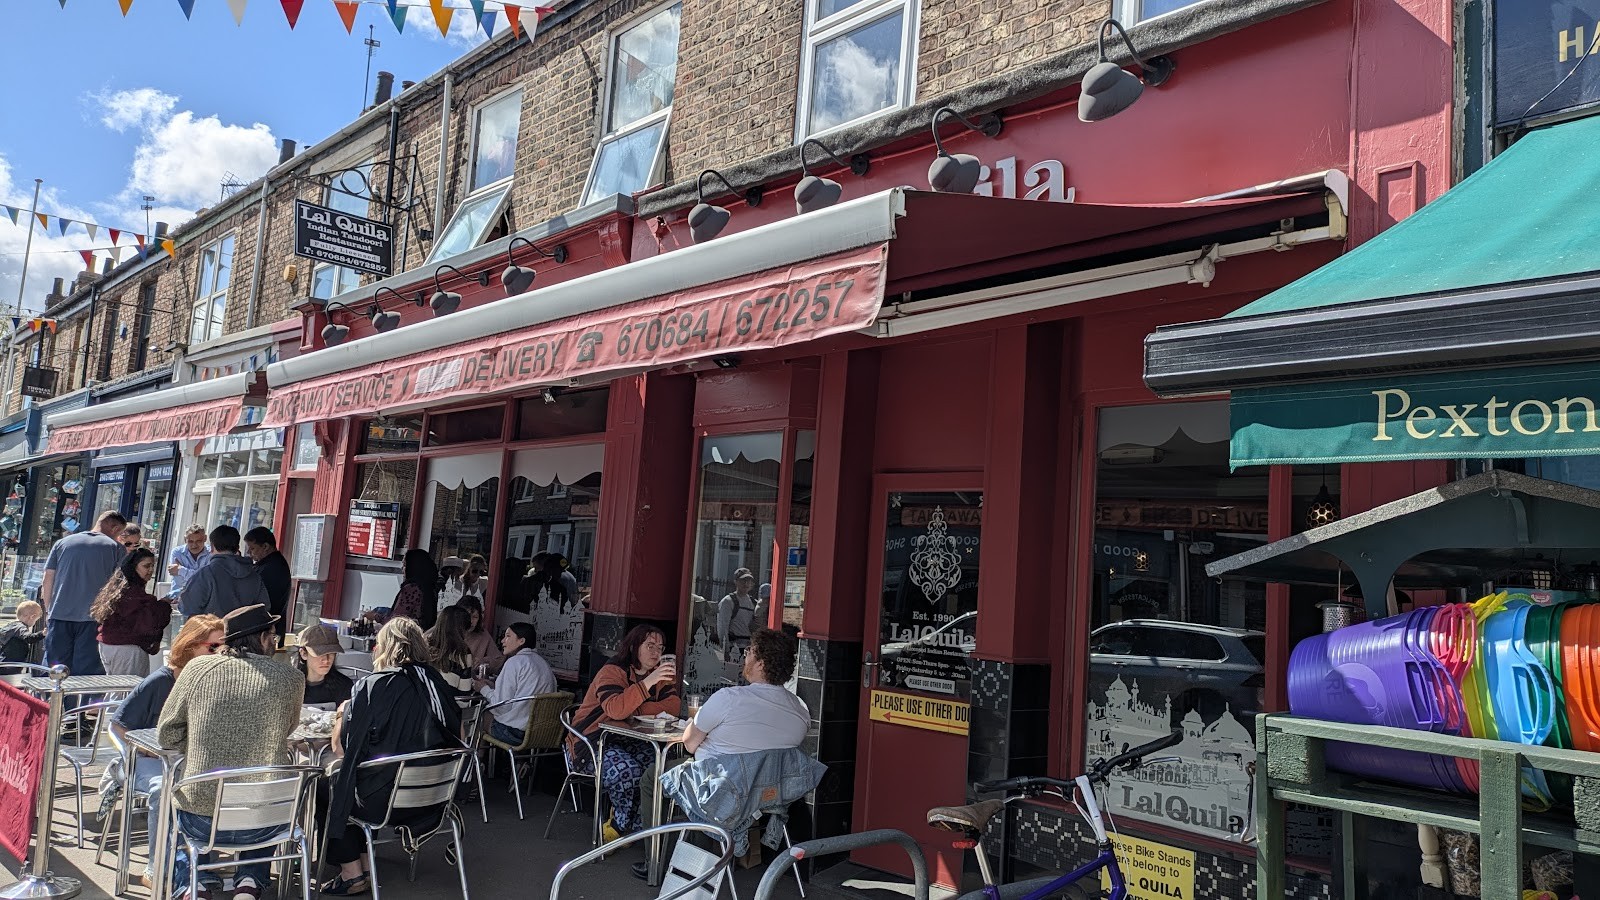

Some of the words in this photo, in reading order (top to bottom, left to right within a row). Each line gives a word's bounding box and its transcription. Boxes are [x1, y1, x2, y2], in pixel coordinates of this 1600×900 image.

[972, 157, 1076, 204] ila
[300, 205, 332, 226] Lal
[335, 216, 389, 241] Quila
[306, 222, 339, 236] Indian
[341, 231, 383, 248] Tandoori
[313, 241, 337, 252] Fully
[339, 247, 378, 261] Licensed
[319, 232, 372, 252] Restaurant
[303, 246, 314, 255] T:
[316, 250, 387, 273] 670684/672257
[272, 387, 334, 418] TAKEAWAY
[335, 374, 395, 407] SERVICE
[463, 338, 564, 383] DELIVERY
[617, 309, 709, 356] 670684
[736, 279, 855, 336] 672257
[173, 408, 231, 434] RESTAURANT
[1371, 388, 1600, 441] Pexton
[912, 611, 930, 621] Est.
[933, 613, 955, 622] 1990
[890, 622, 977, 649] LalQuila
[908, 678, 922, 686] PLEASE
[942, 682, 952, 690] DOOR
[874, 693, 904, 712] PLEASE
[906, 698, 922, 715] USE
[925, 701, 952, 719] OTHER
[1121, 785, 1244, 833] LalQuila
[1109, 838, 1133, 853] hese
[1136, 845, 1155, 858] Bike
[1158, 850, 1191, 867] Stands
[1133, 857, 1166, 877] belong
[1169, 867, 1180, 878] to
[1139, 877, 1183, 899] QUILA
